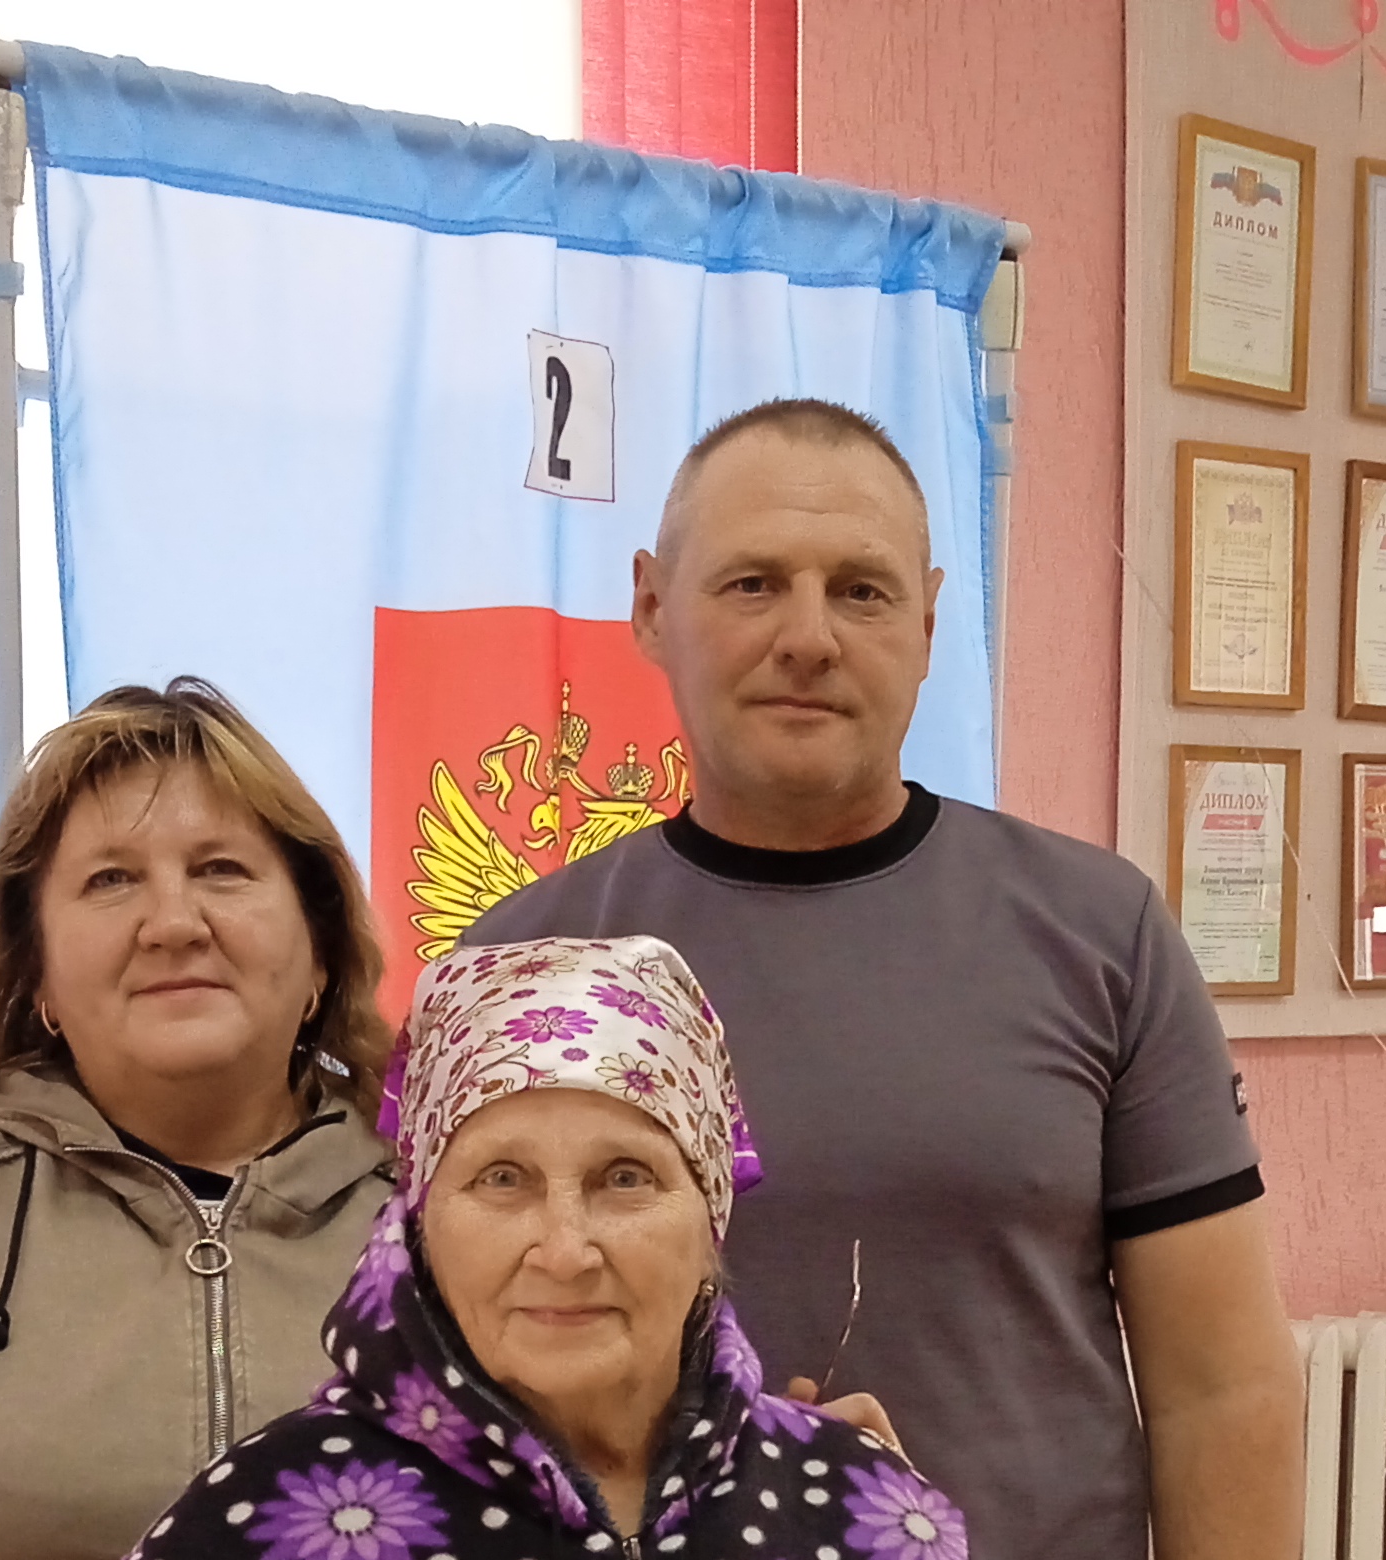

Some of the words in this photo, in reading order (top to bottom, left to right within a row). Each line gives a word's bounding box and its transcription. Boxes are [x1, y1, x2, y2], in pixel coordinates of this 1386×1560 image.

[1213, 211, 1279, 240] ДИПЛОМ
[546, 356, 572, 481] 2
[1200, 791, 1269, 811] ДИПЛОМ
